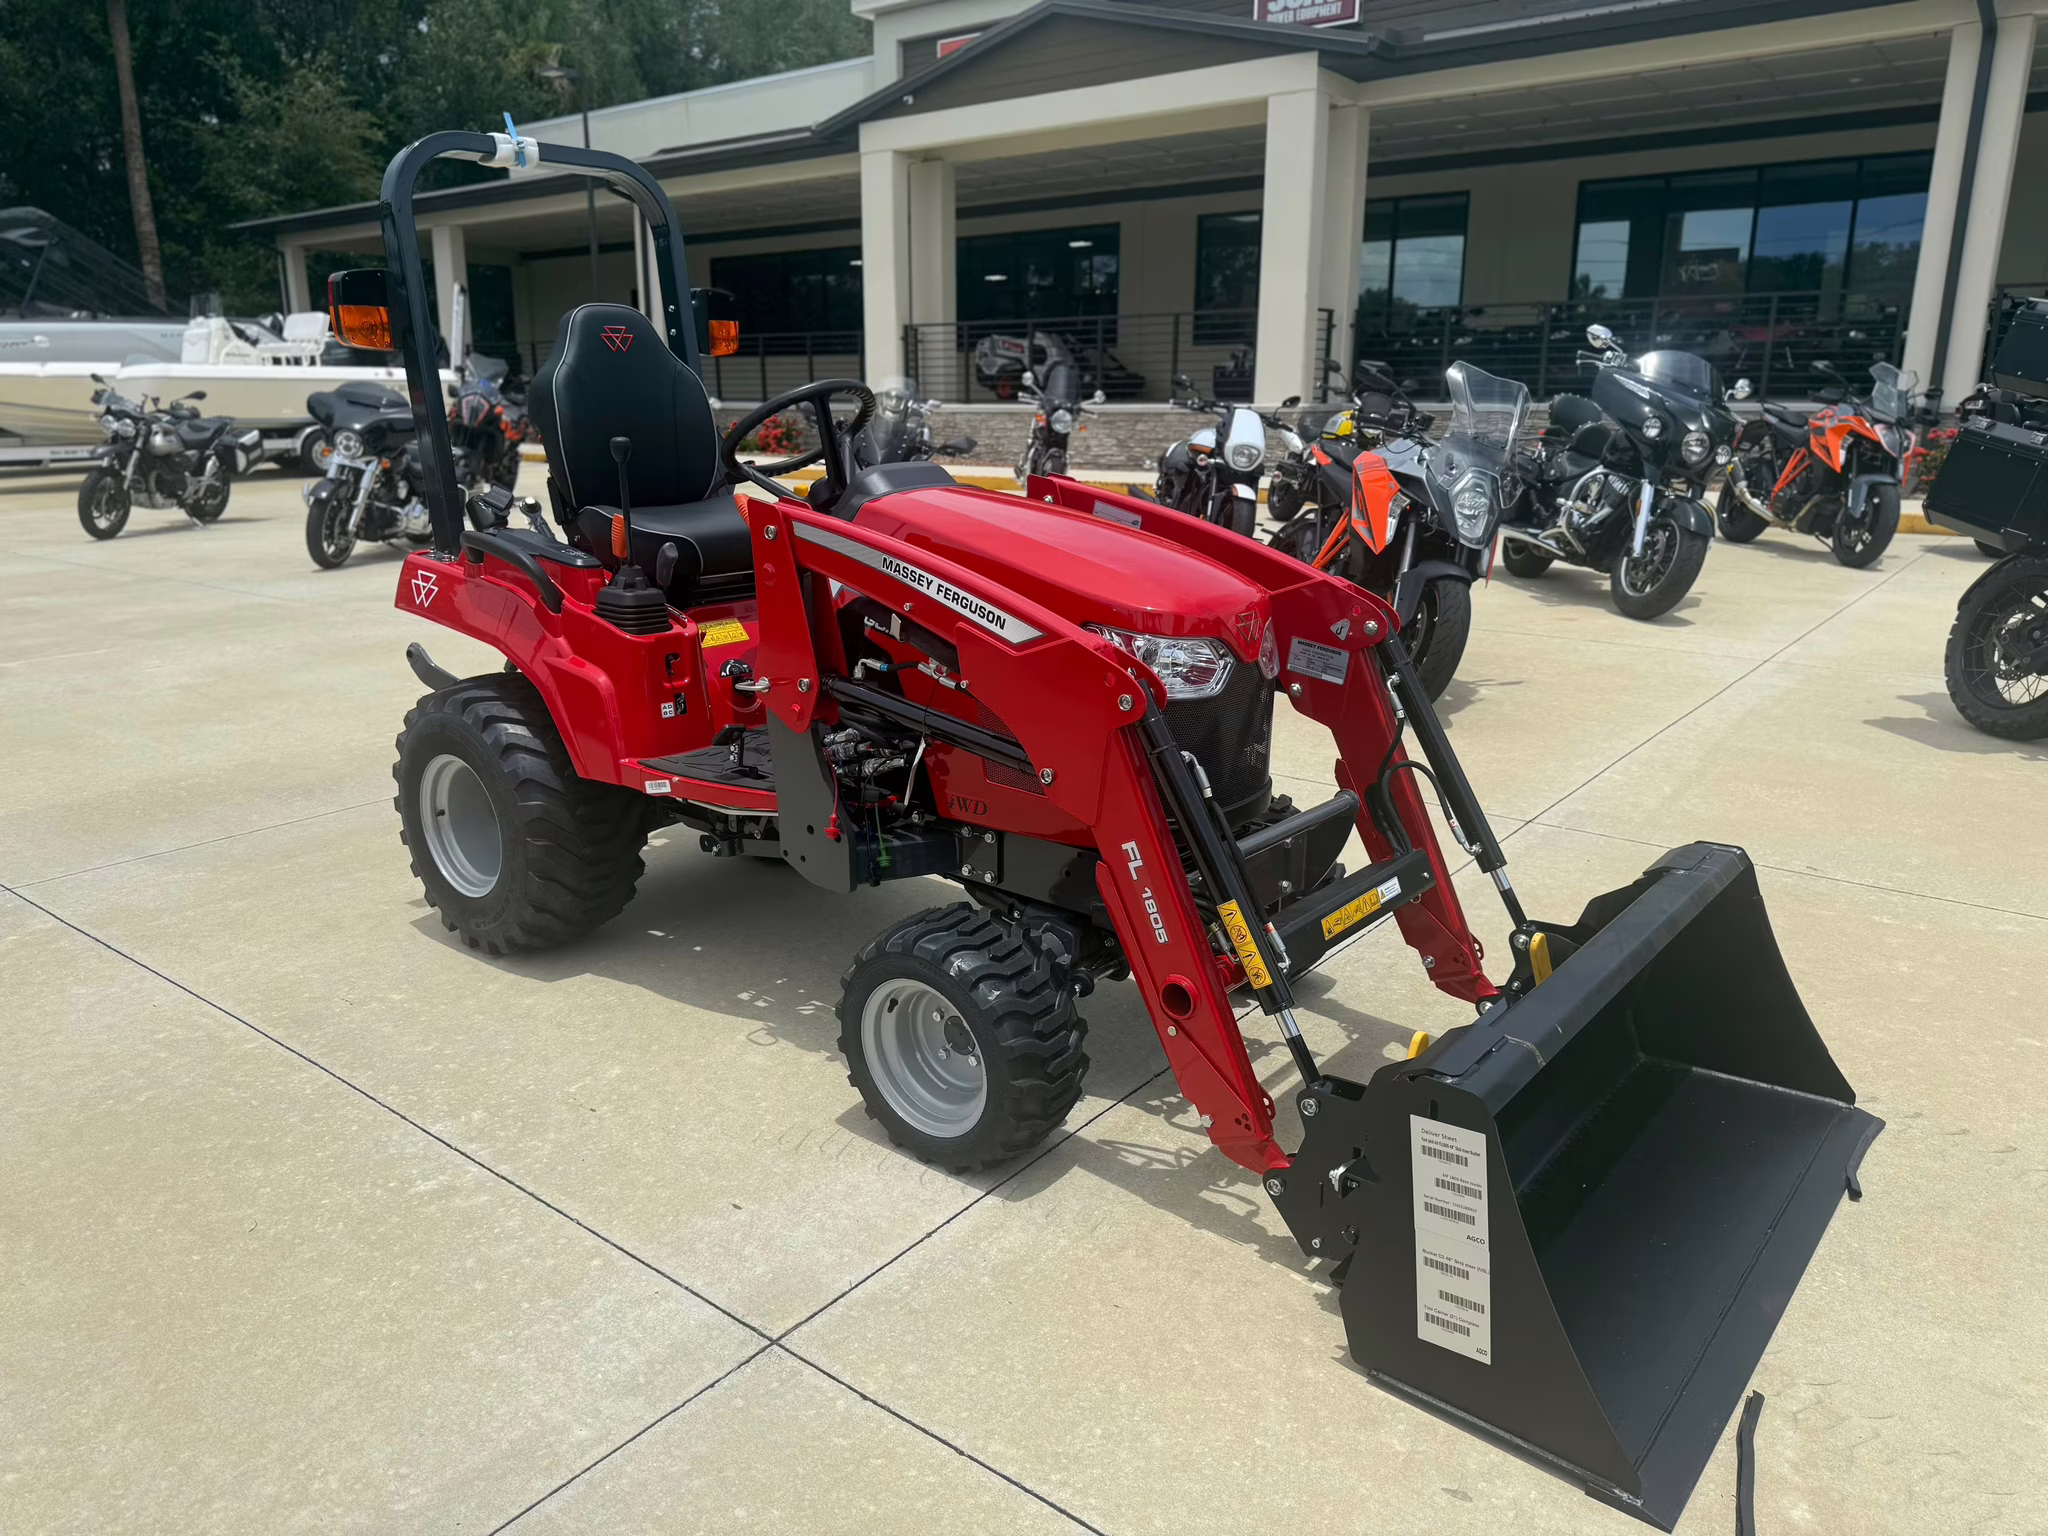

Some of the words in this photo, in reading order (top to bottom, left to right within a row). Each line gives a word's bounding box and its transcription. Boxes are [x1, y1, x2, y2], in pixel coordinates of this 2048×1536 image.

[1295, 2, 1342, 21] EQUIPMENT
[882, 556, 934, 591] MASSEY
[936, 583, 1007, 630] FERGUSON
[1297, 640, 1316, 649] MASSEY
[1316, 645, 1342, 656] FERGUSON
[946, 794, 989, 816] 4WD
[1121, 841, 1144, 880] FL
[1141, 886, 1169, 944] 1805
[1421, 1128, 1440, 1138] Deliver
[1441, 1134, 1457, 1143] Sheet
[1466, 1235, 1485, 1245] AGCO
[1458, 1317, 1479, 1328] Complete
